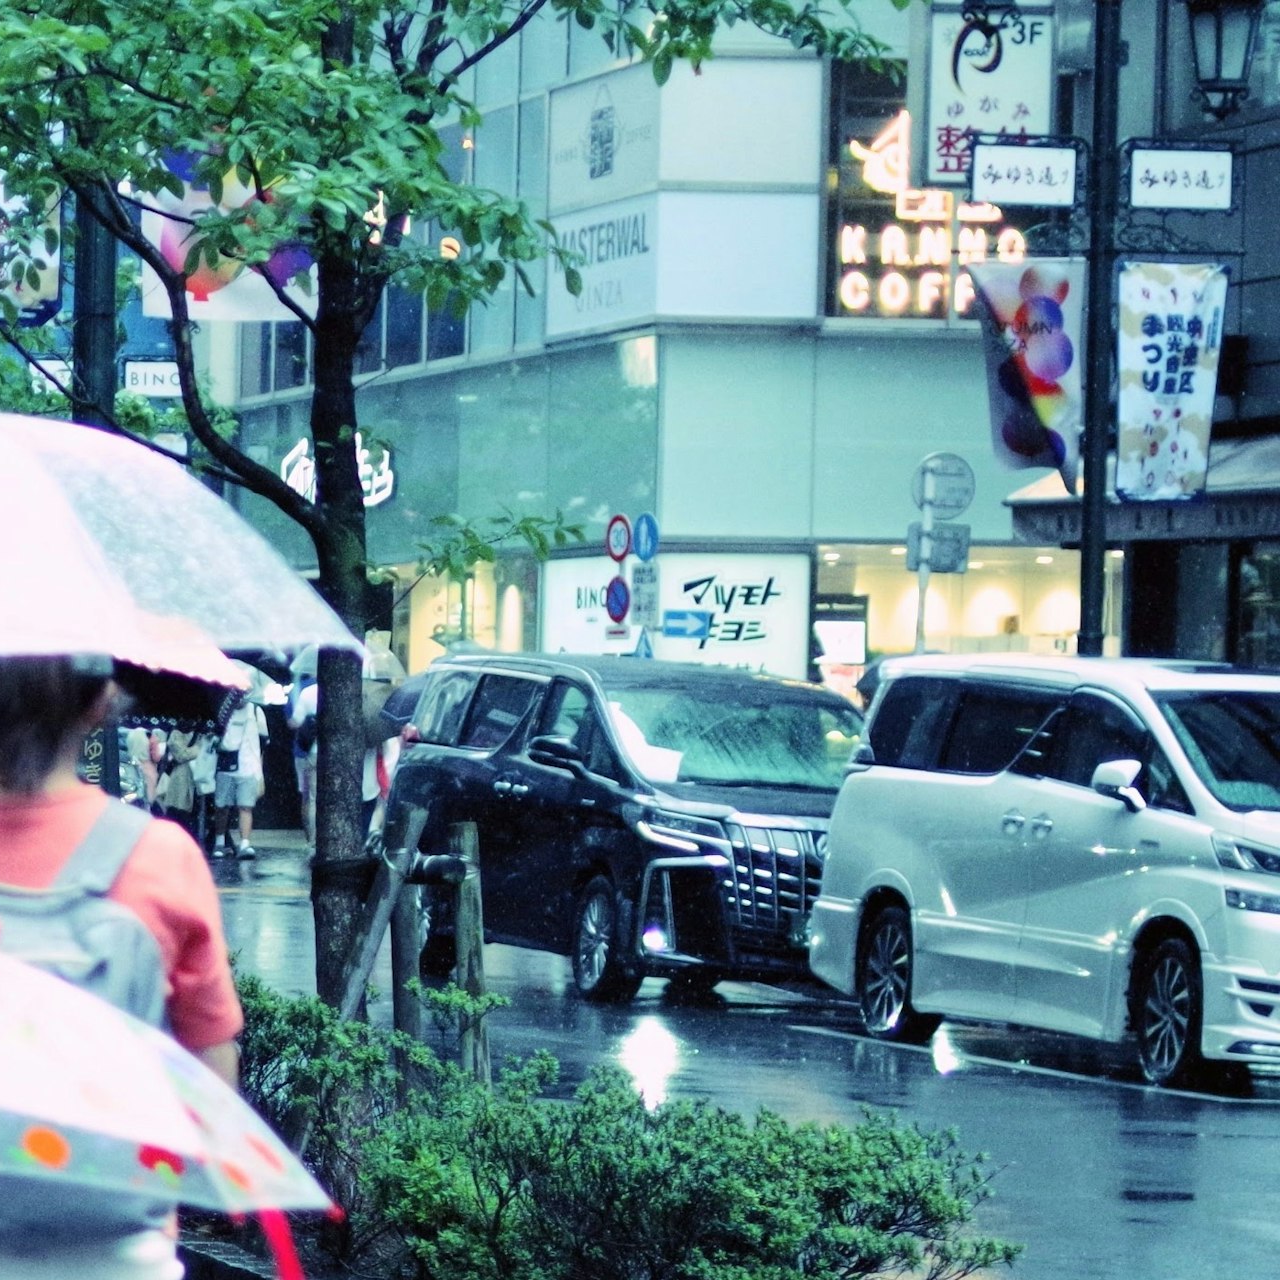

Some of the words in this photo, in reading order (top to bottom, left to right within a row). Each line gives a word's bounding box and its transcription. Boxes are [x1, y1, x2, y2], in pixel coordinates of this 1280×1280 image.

[1011, 22, 1045, 45] 3F
[947, 97, 1031, 121] ゆがみ
[982, 164, 1069, 187] みゆき通り
[1139, 168, 1225, 189] みゆき通り
[841, 271, 976, 312] COFF
[1142, 313, 1164, 392] まつり
[683, 575, 781, 613] マツモト
